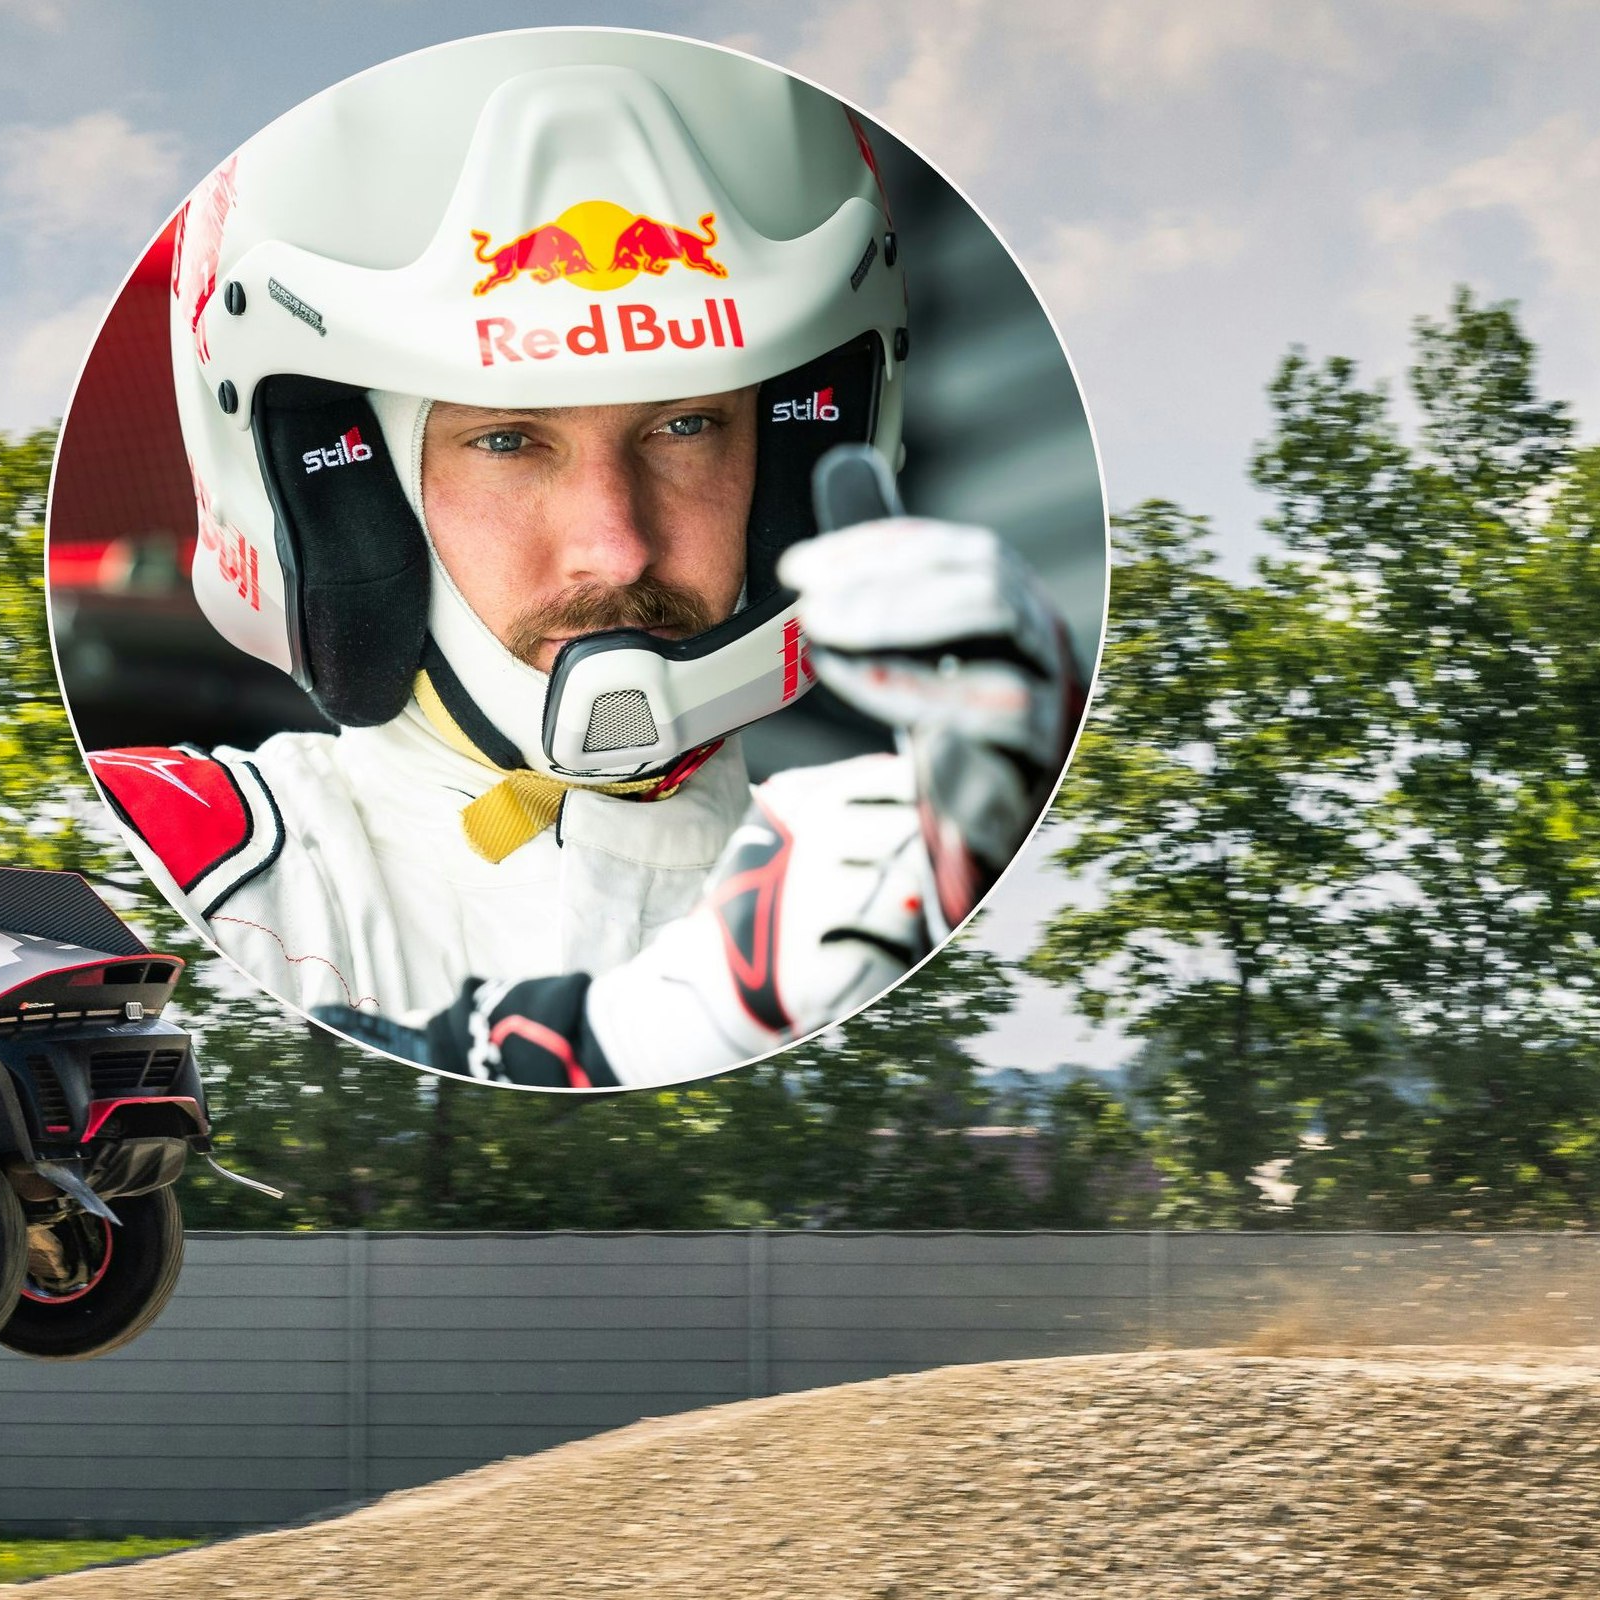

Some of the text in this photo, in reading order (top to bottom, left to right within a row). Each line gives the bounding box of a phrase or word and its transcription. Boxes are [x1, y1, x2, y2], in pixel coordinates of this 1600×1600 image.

[475, 298, 744, 367] Red Bull
[771, 390, 840, 422] stilo
[302, 432, 373, 474] stilo
